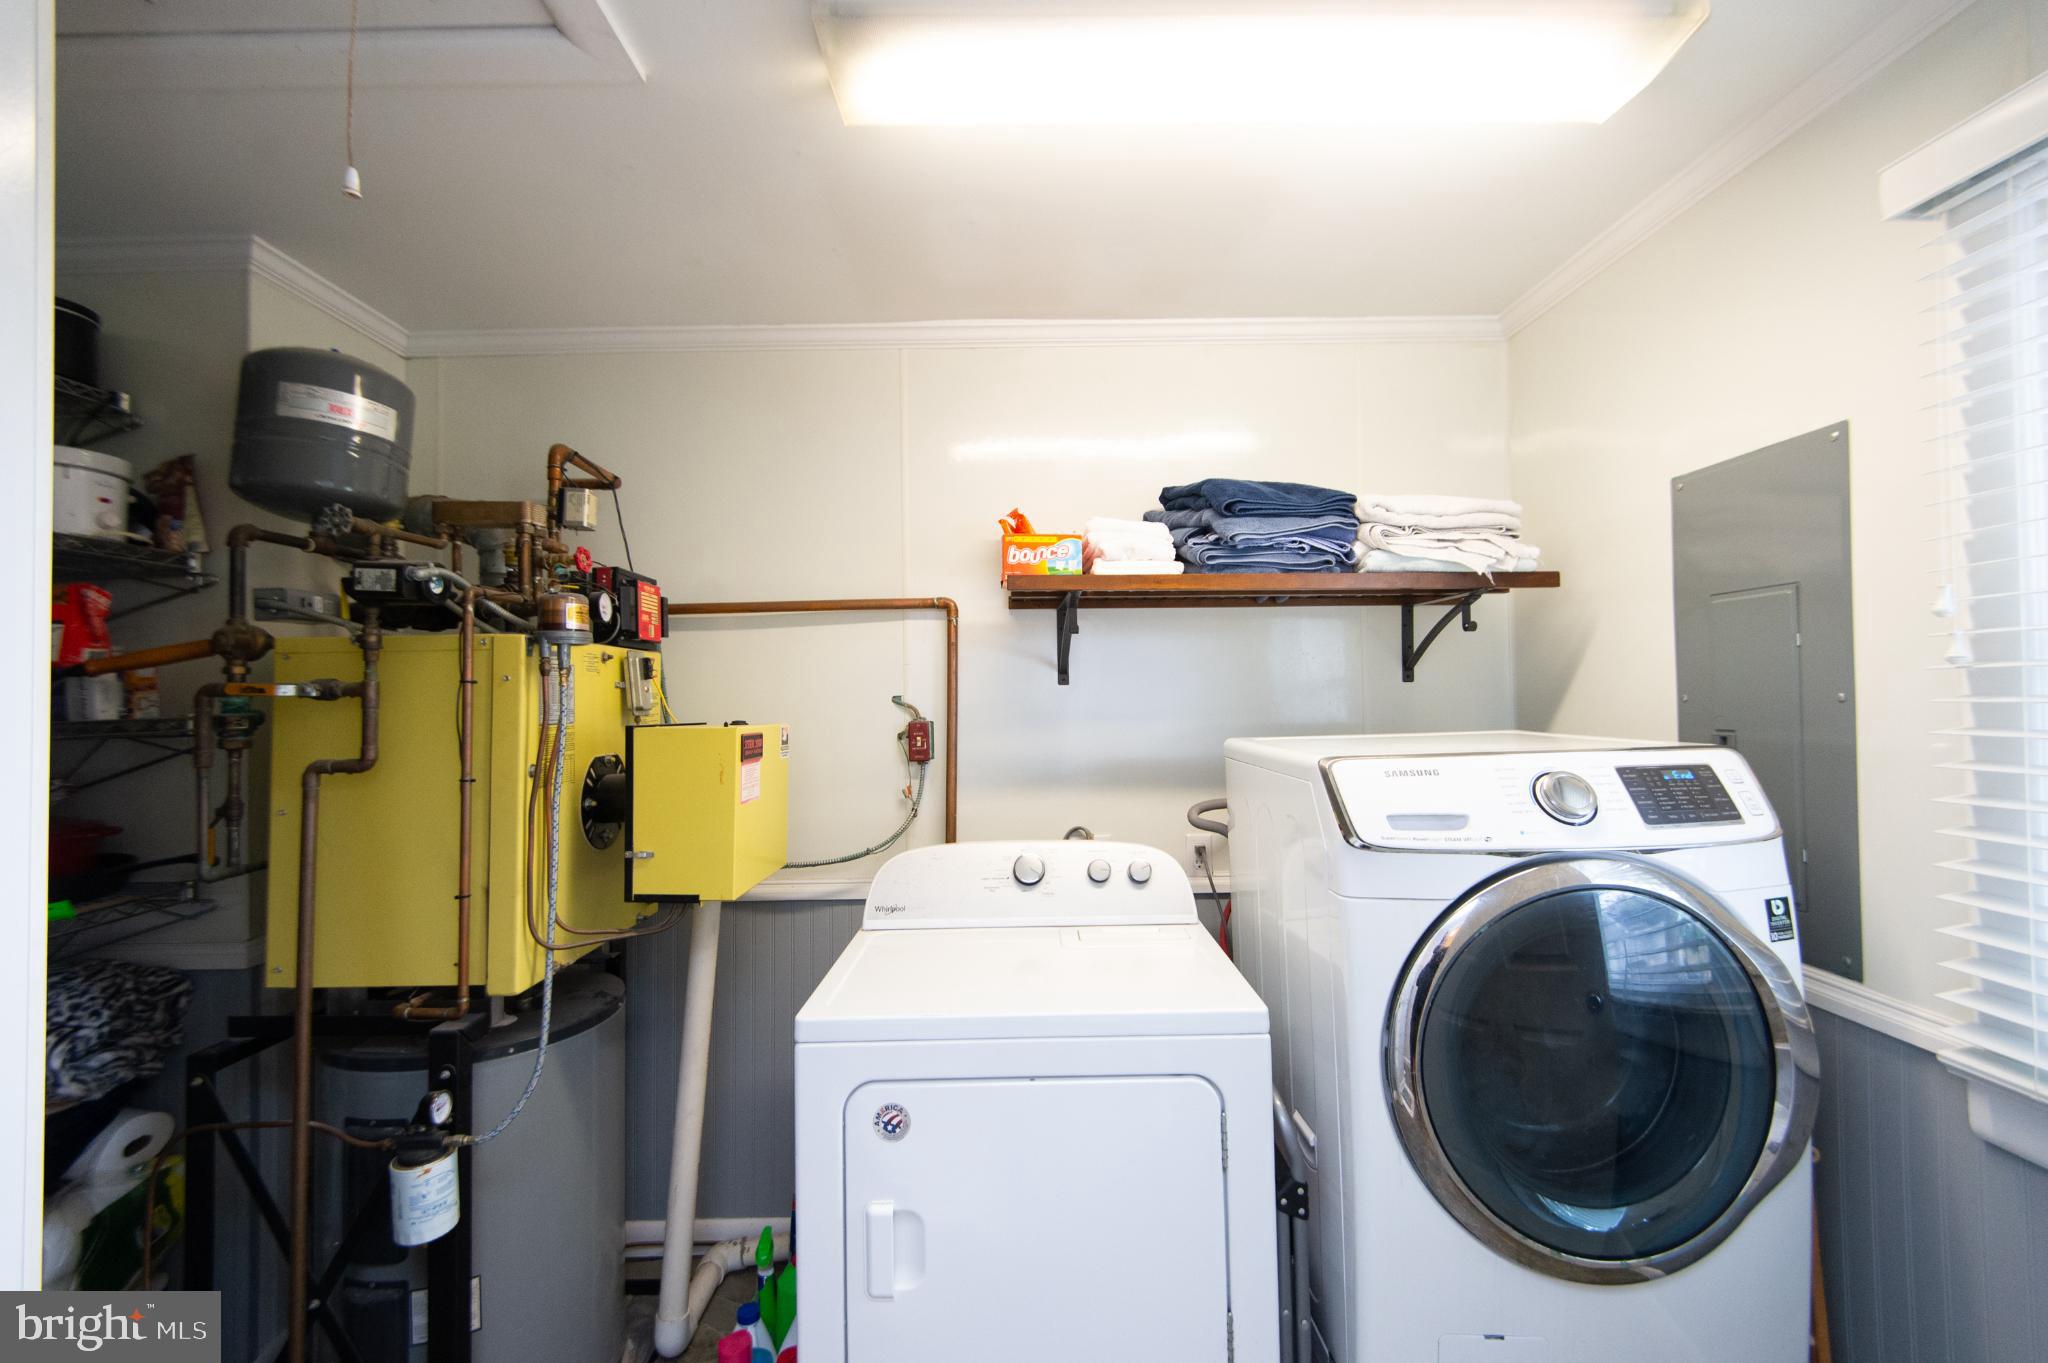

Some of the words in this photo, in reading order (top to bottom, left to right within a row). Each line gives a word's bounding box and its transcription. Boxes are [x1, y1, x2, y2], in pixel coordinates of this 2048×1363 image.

[1007, 544, 1070, 565] bounce
[1384, 768, 1440, 778] SAMSUNG
[874, 903, 906, 916] Whirlpool
[874, 1104, 904, 1127] AMERICA
